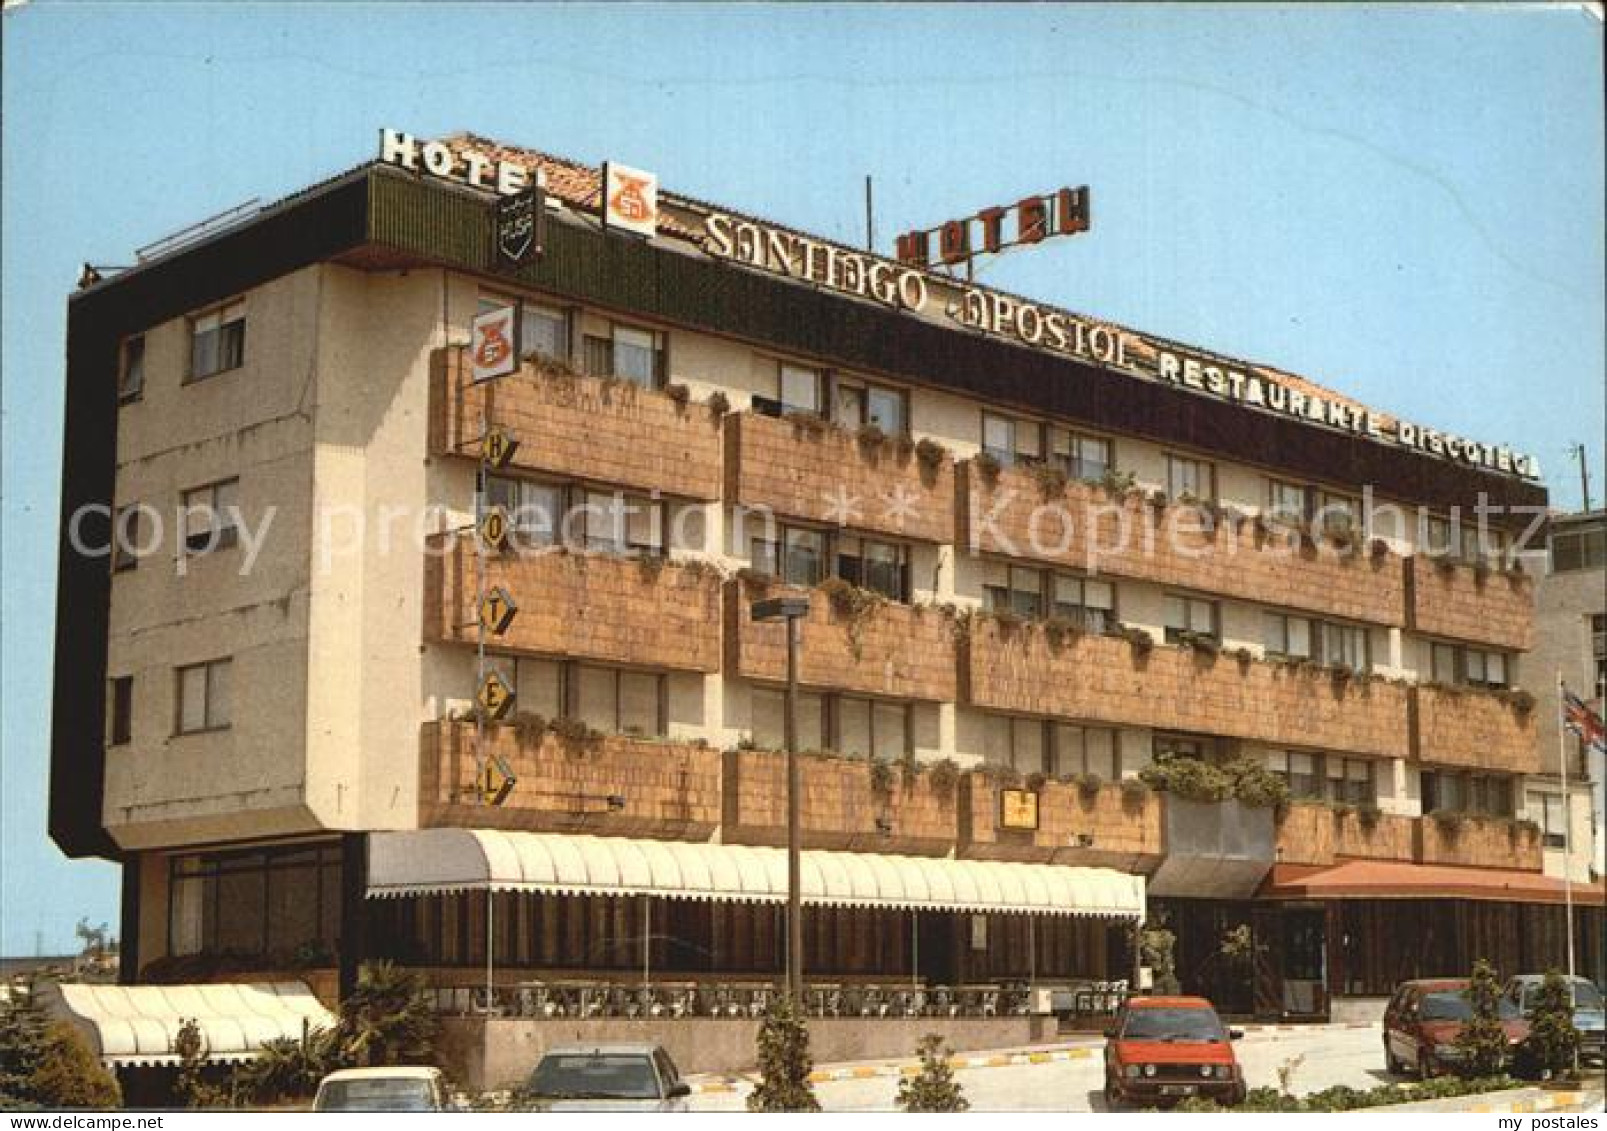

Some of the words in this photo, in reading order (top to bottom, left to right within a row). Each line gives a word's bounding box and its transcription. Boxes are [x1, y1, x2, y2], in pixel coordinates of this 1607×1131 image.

[379, 128, 562, 208] HOTEL
[896, 185, 1090, 262] HOTEL
[704, 213, 928, 313] SANTIAGO
[963, 289, 1136, 370] APOSTOL
[1159, 351, 1382, 437] RESTAURANTE
[1398, 420, 1541, 480] DISCOTECA
